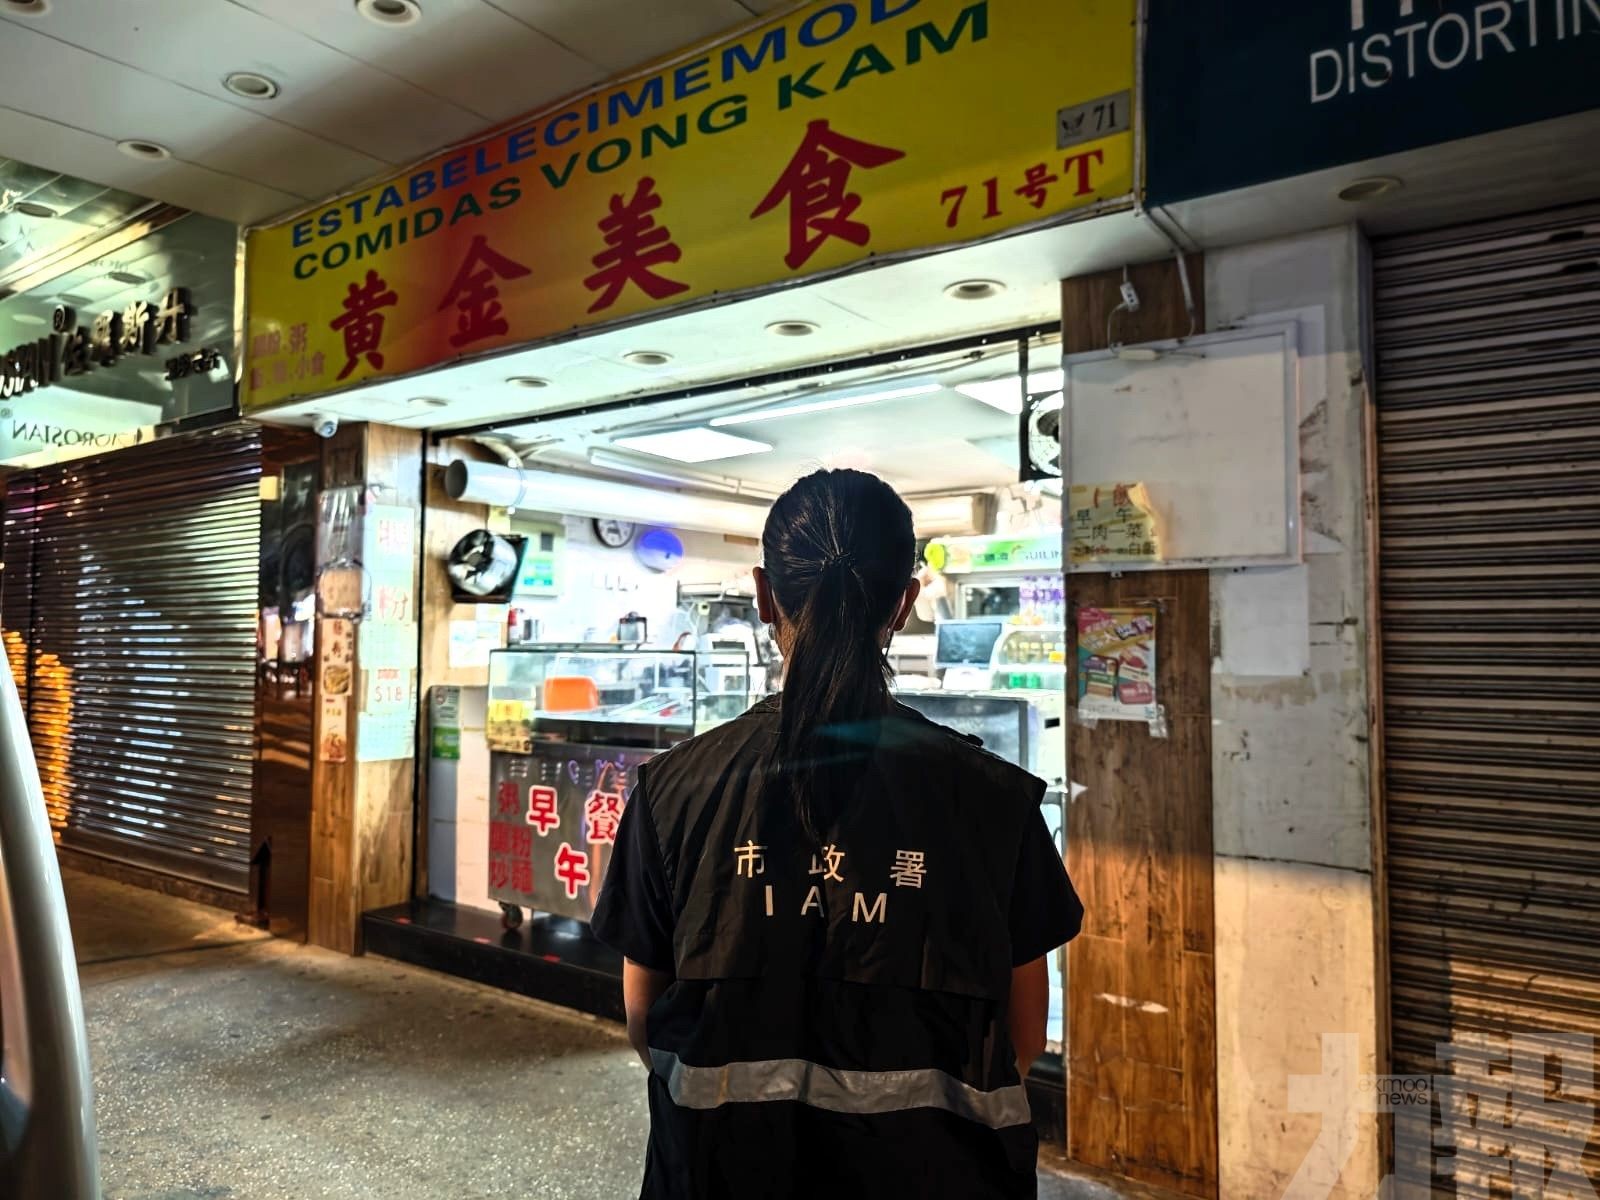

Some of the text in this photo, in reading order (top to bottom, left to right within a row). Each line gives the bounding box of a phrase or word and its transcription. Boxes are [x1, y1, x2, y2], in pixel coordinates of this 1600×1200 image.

[292, 1, 989, 280] COMIDAS VONG KAM
[1093, 101, 1117, 131] 71
[734, 840, 927, 889] 市政署
